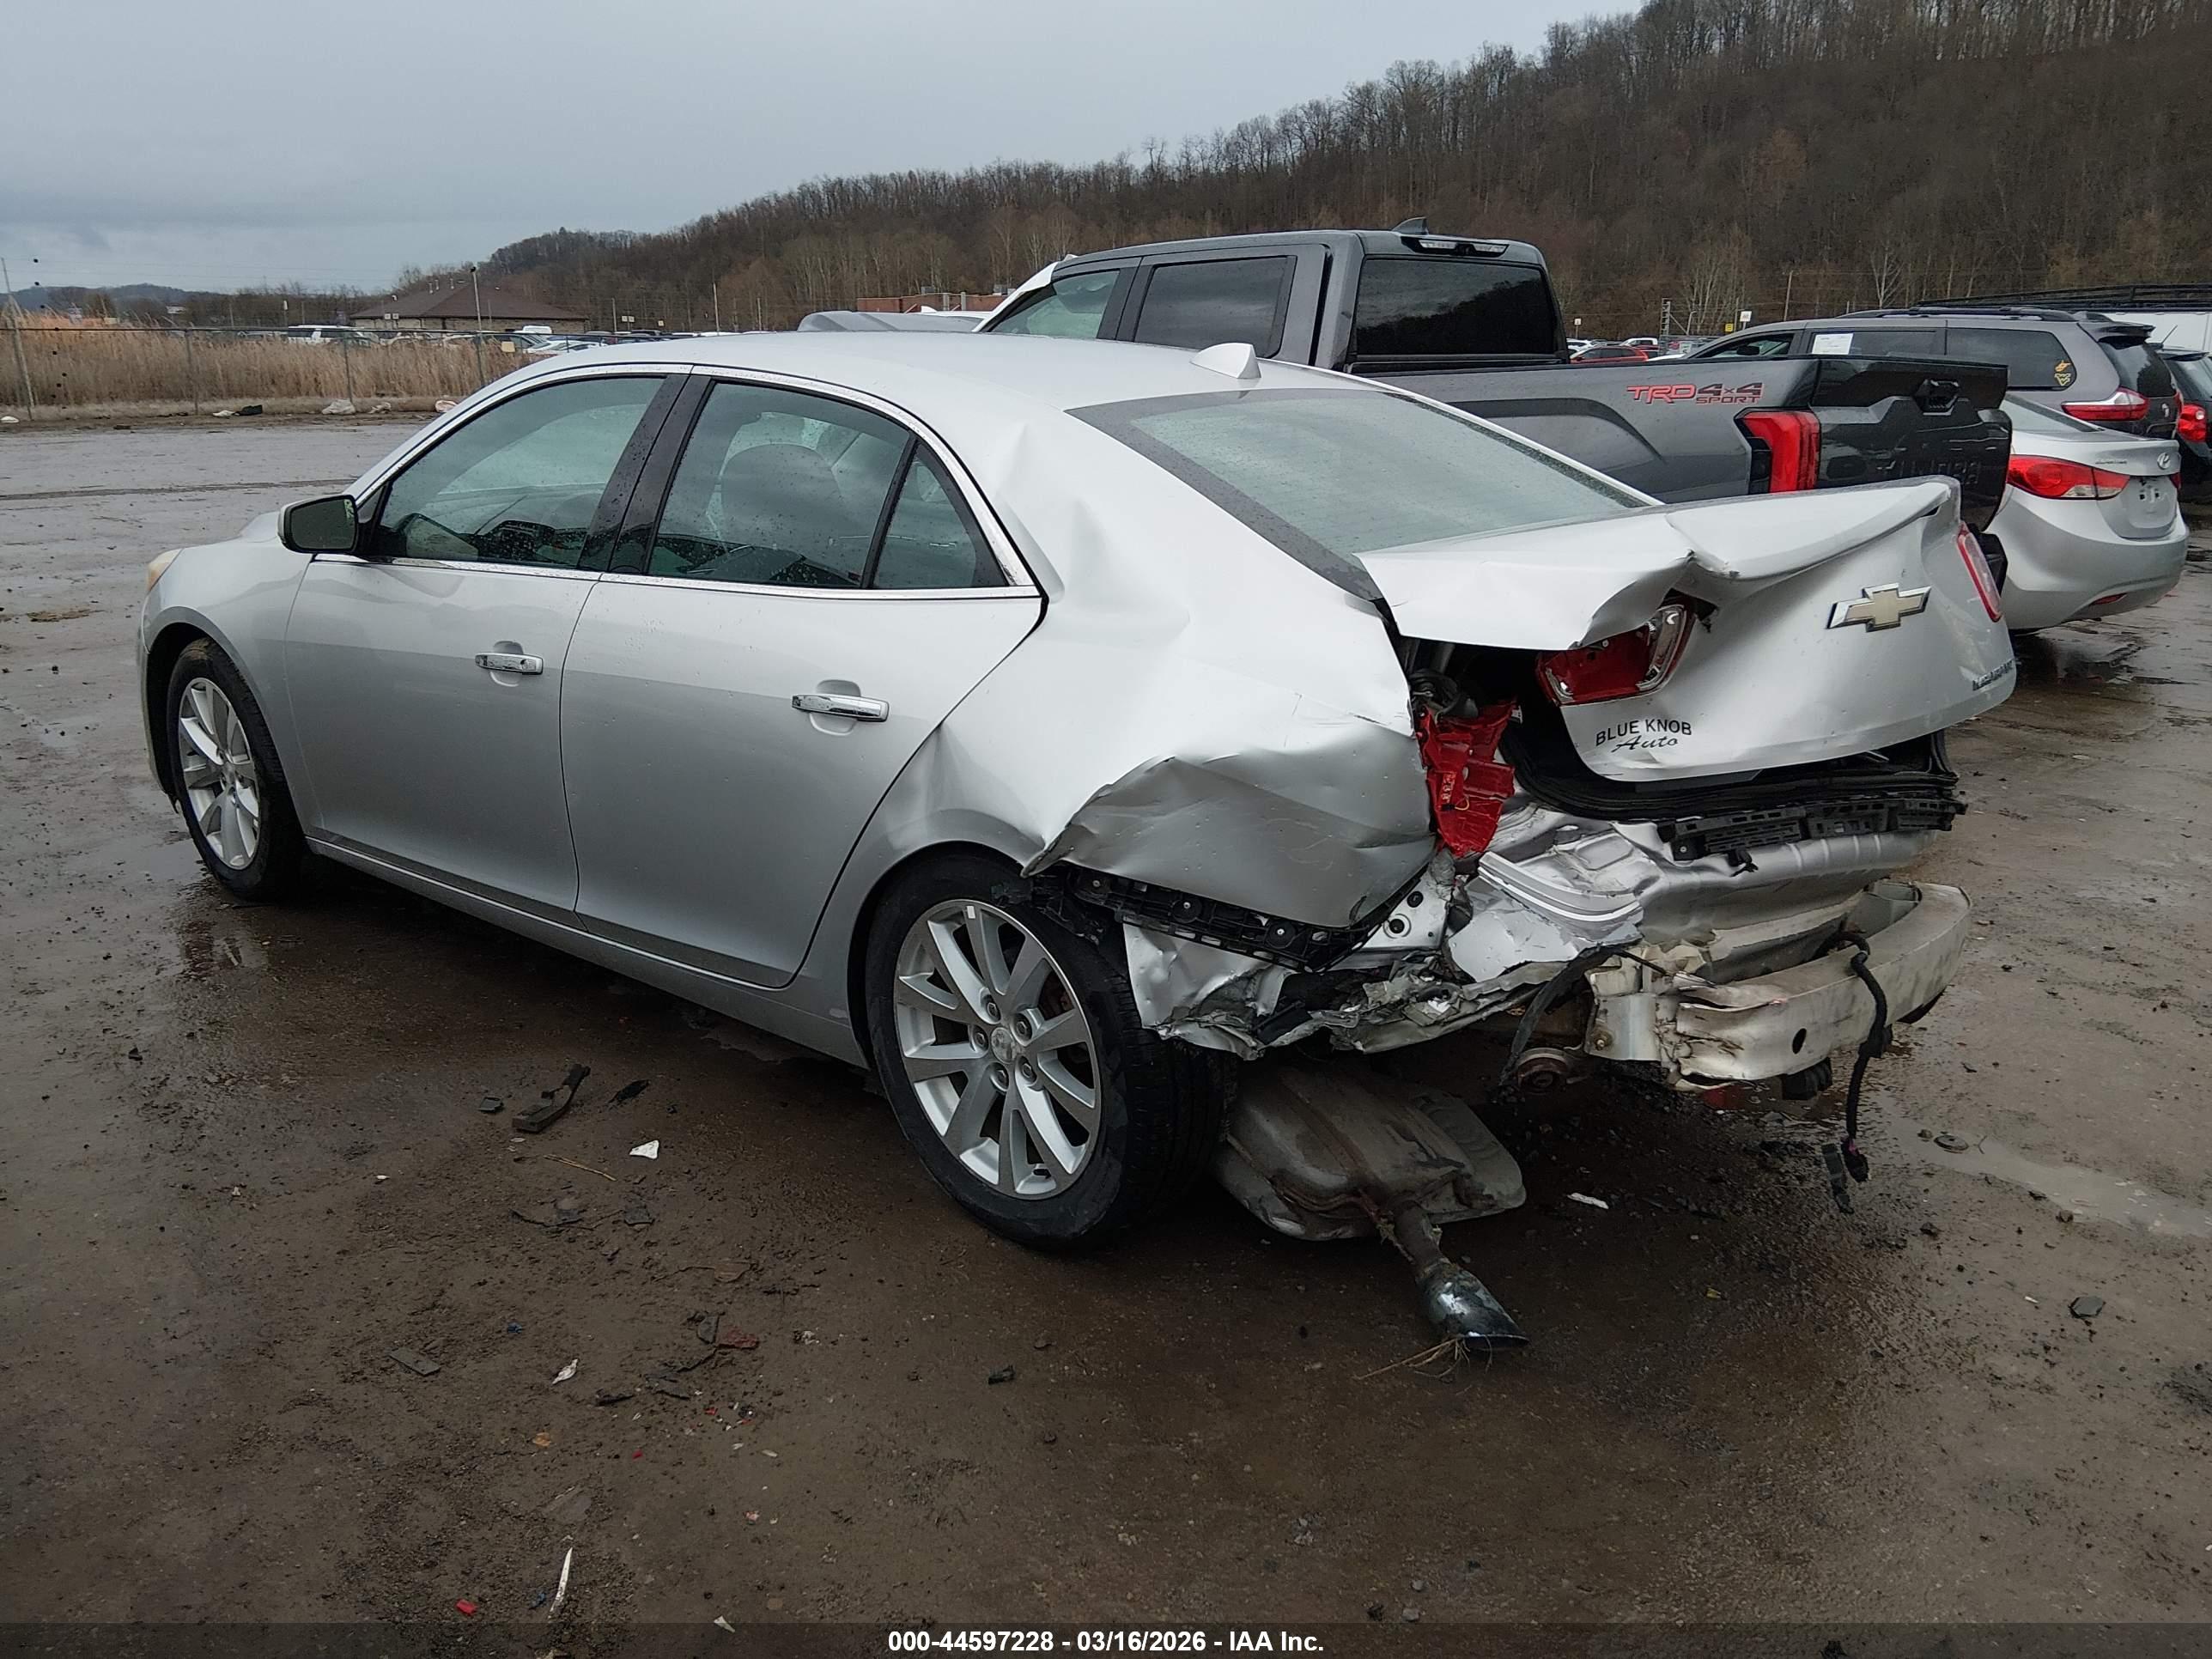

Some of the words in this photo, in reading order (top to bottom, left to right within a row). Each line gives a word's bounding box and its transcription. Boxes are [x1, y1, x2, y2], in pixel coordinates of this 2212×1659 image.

[1626, 384, 1697, 404] TRD
[1698, 382, 1763, 397] 4x4
[1696, 396, 1762, 404] SPORT
[1595, 720, 1640, 747] BLUE
[1645, 718, 1692, 736] KNOB
[1611, 735, 1679, 753] Auto
